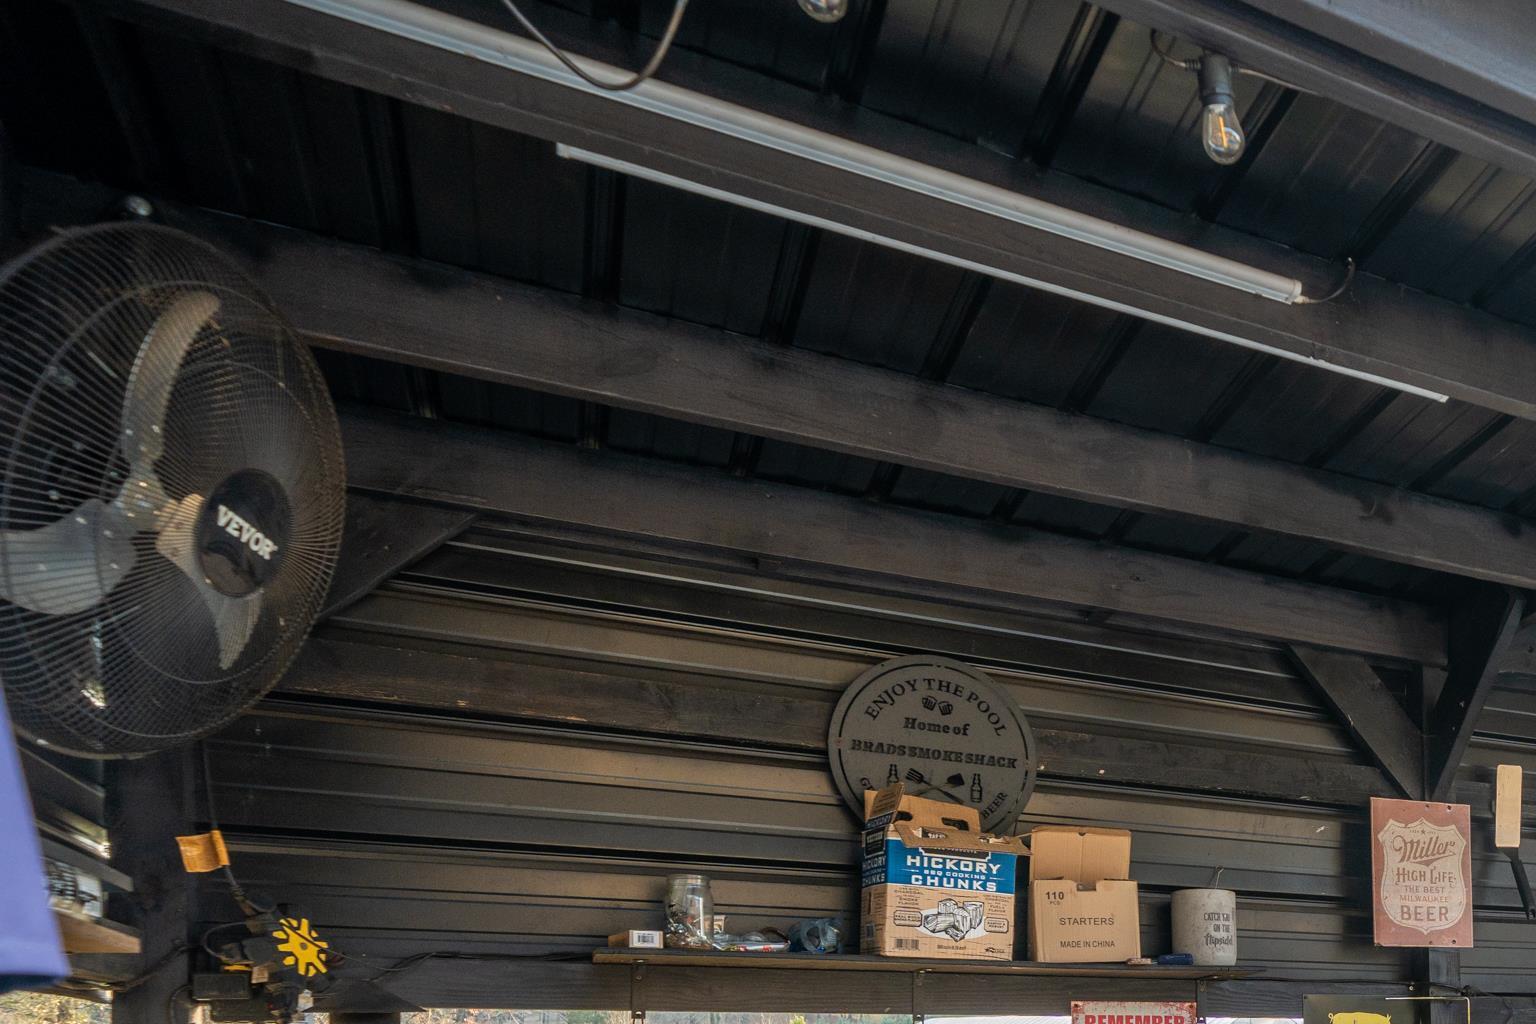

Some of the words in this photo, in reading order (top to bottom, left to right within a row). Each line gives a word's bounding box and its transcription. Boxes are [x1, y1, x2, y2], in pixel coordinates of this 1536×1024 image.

[217, 504, 278, 560] VEVOR
[864, 679, 919, 721] ENJOY
[923, 678, 965, 698] THE
[967, 691, 1008, 736] POOL
[903, 717, 950, 734] Home
[953, 723, 970, 736] of
[907, 746, 963, 763] SMOKE
[964, 751, 1018, 769] SHACK
[981, 792, 1008, 819] BEER
[1392, 835, 1455, 863] Miller
[862, 854, 886, 870] HICKORY
[906, 855, 1001, 875] HICKORY
[862, 873, 886, 887] CHUNKS
[911, 874, 997, 892] CHUNKS
[945, 871, 986, 880] COOKING
[1046, 891, 1064, 900] 110
[1404, 885, 1420, 893] THE
[1424, 885, 1445, 894] BEST
[1400, 894, 1449, 903] MILWAUKEE
[1203, 912, 1221, 922] CATCH
[1400, 905, 1449, 921] BEER
[1059, 917, 1114, 926] STARTERS
[1213, 924, 1221, 933] ON
[1221, 924, 1231, 933] THE
[1092, 940, 1115, 948] CHINA
